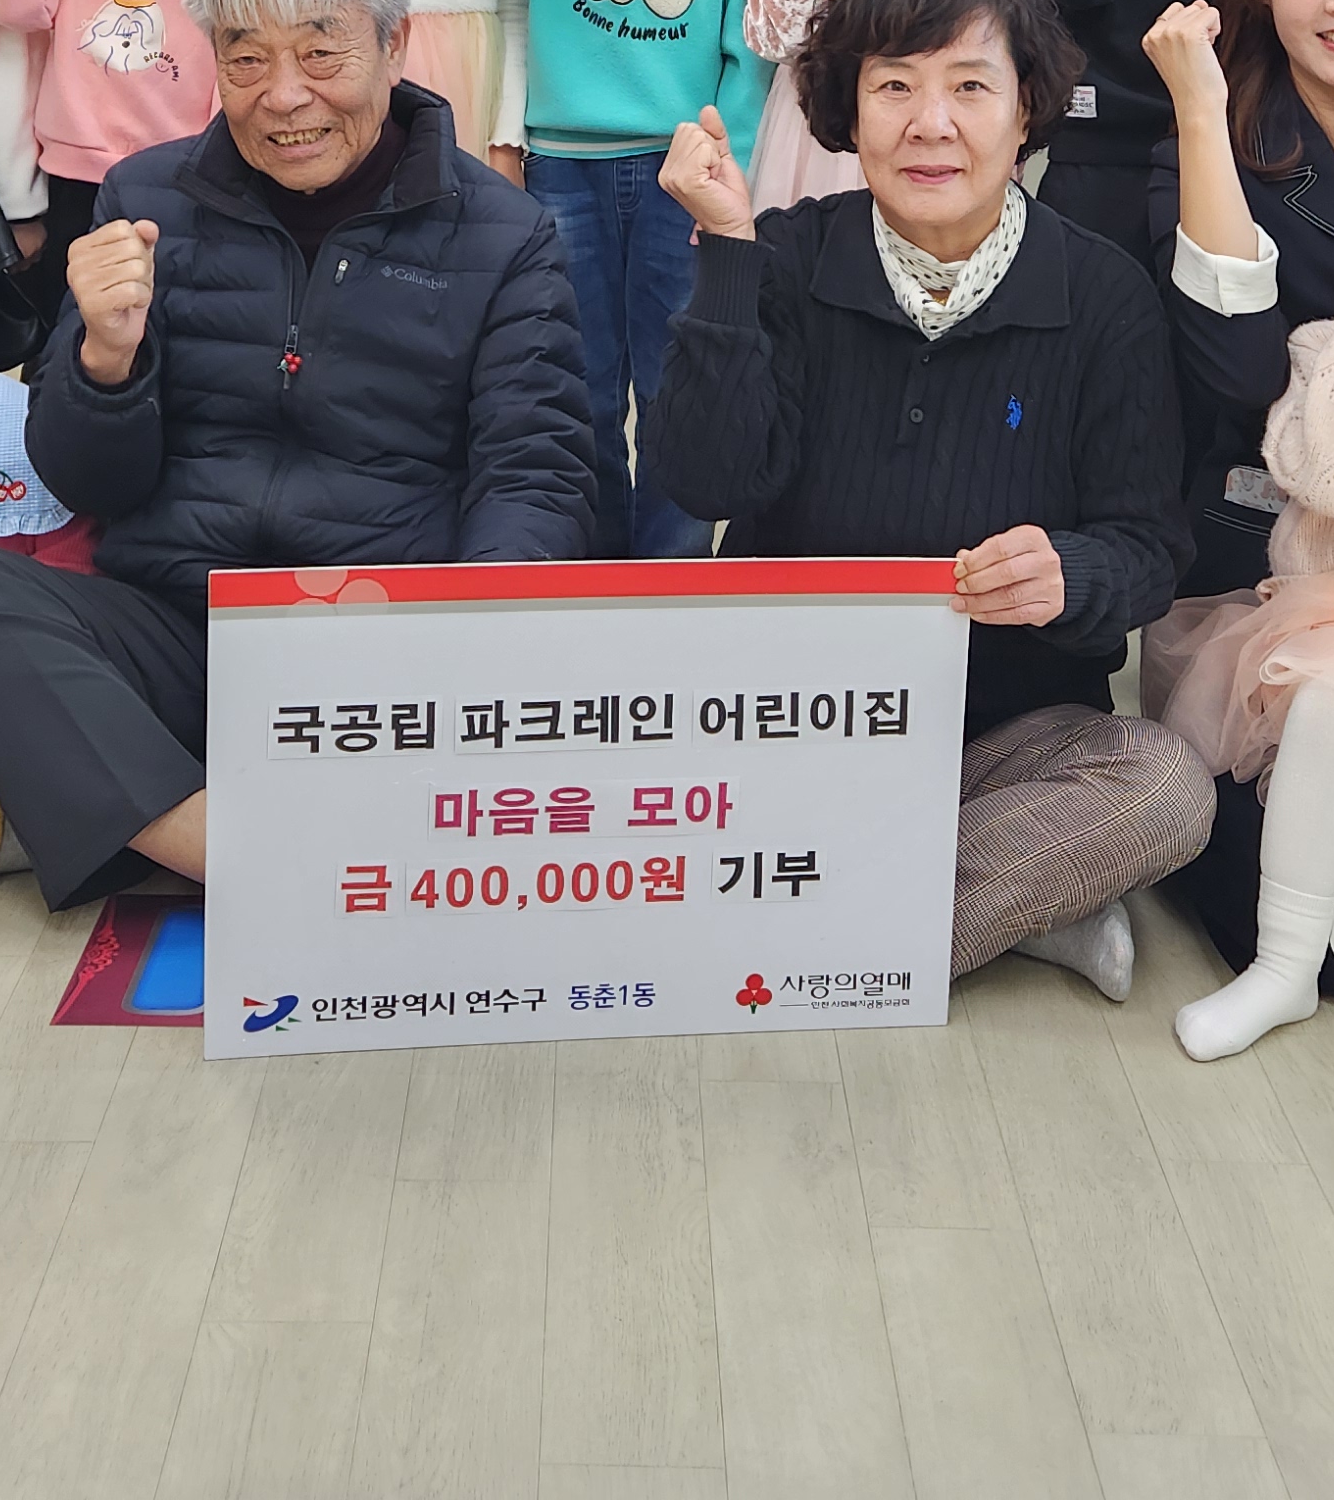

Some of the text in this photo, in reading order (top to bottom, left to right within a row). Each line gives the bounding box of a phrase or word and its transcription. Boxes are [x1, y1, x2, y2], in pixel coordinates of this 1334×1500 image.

[617, 17, 689, 41] humeur
[394, 268, 448, 290] Columbia
[271, 688, 911, 753] 국공립 파크레인 어린이집
[434, 781, 734, 838] 마음을 모아
[719, 850, 821, 898] 기부
[311, 982, 656, 1023] 인천광역시 연수구 동춘1동
[779, 971, 911, 1000] 사랑의열매
